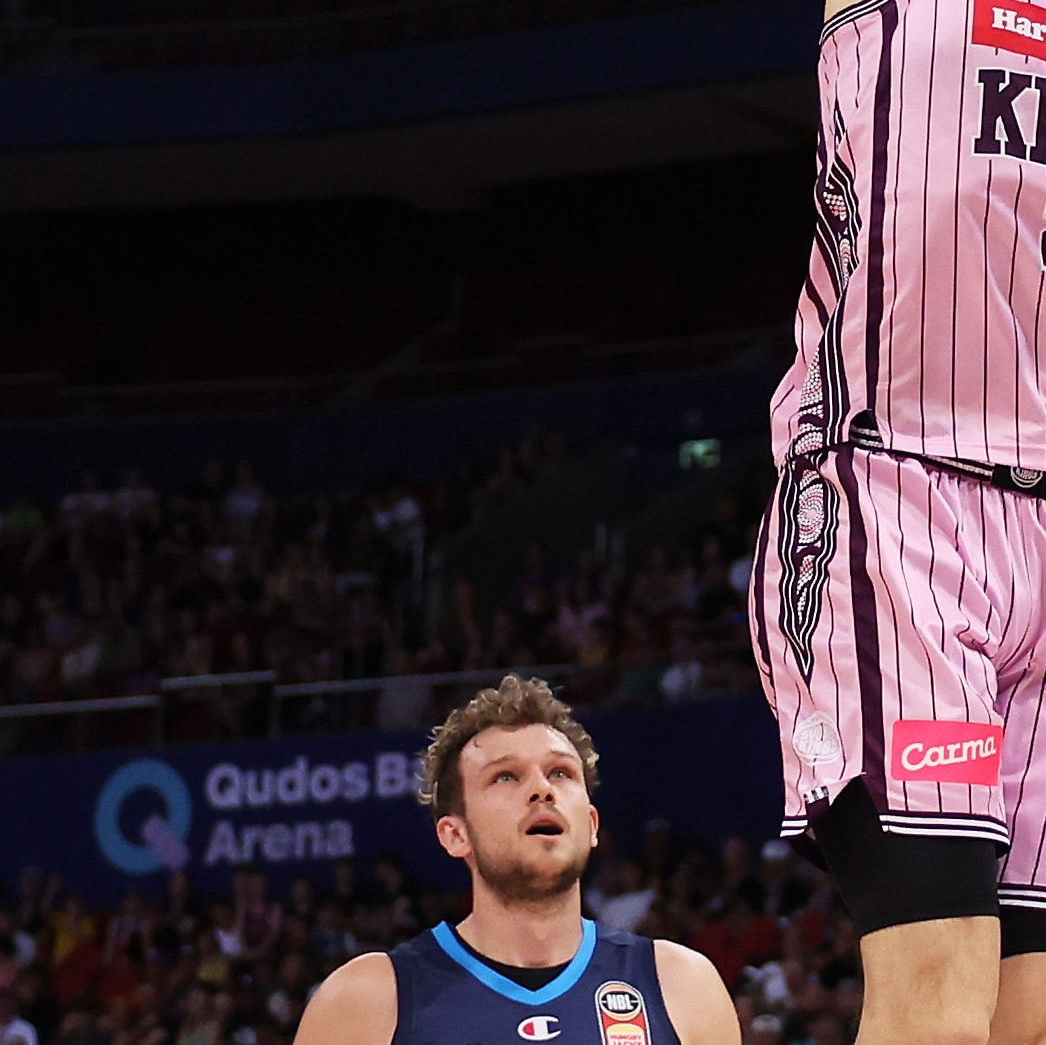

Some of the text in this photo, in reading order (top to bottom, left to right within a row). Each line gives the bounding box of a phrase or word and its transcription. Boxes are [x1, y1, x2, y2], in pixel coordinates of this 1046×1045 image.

[901, 736, 997, 771] Carma
[205, 755, 370, 810] Qudos
[205, 819, 354, 865] Arena
[606, 994, 634, 1010] NBL
